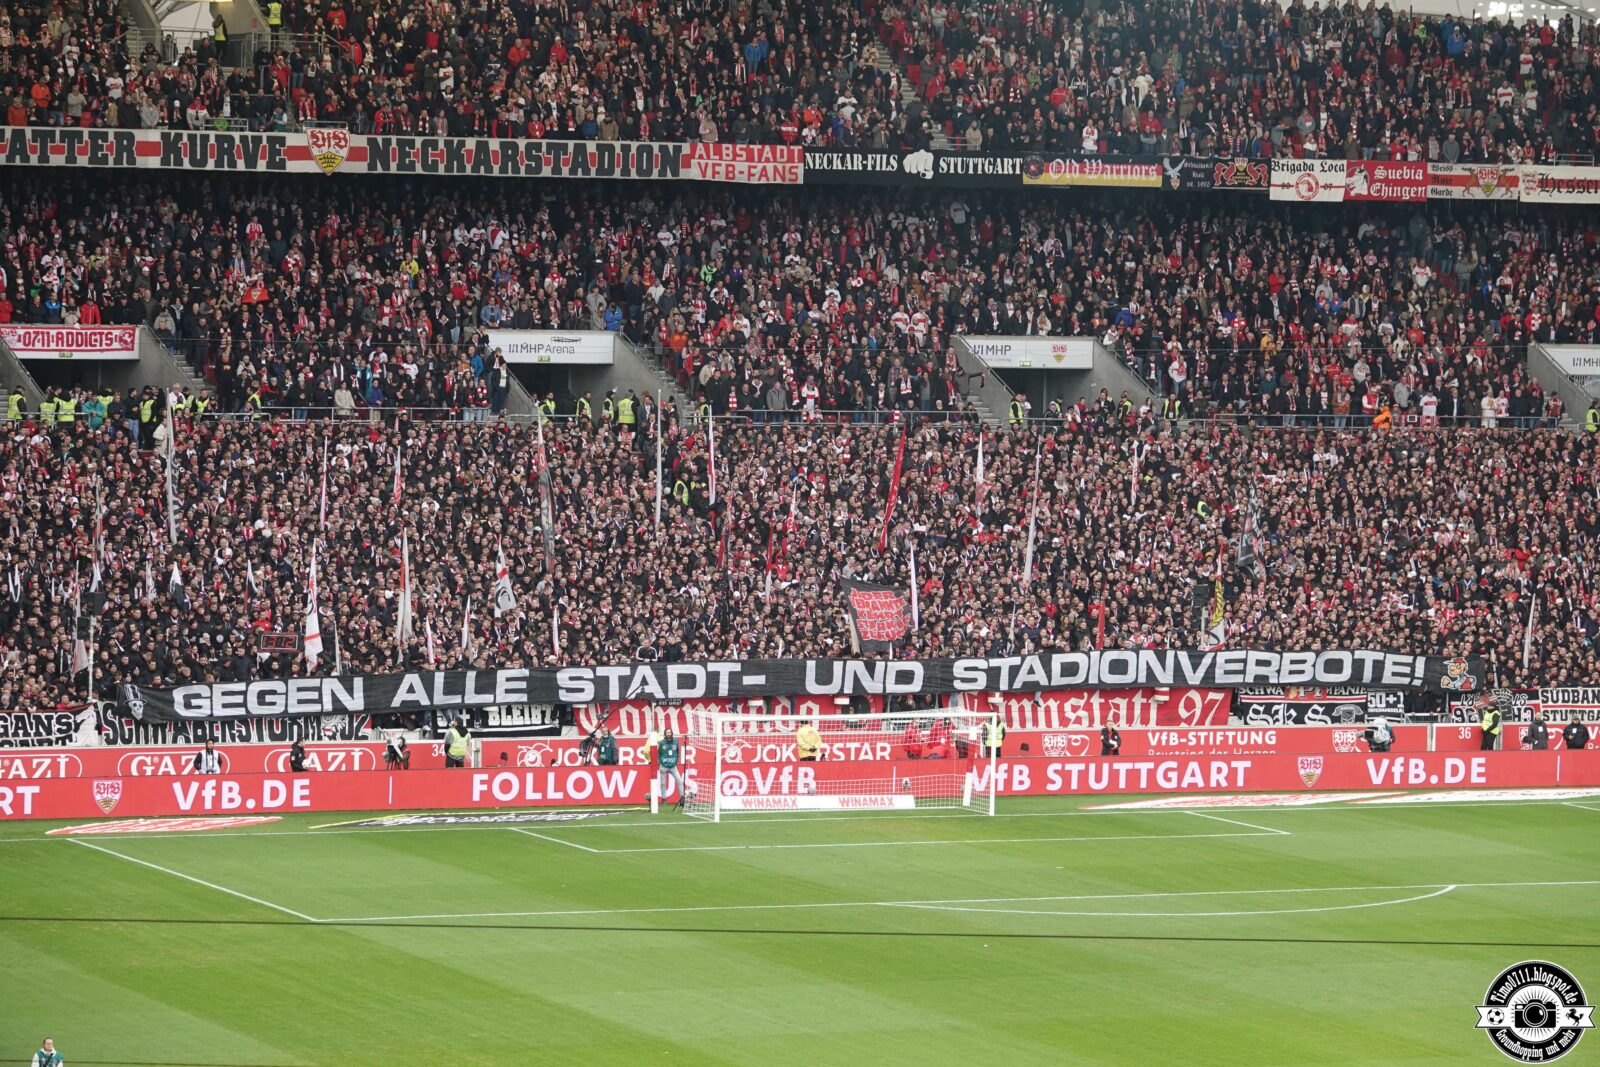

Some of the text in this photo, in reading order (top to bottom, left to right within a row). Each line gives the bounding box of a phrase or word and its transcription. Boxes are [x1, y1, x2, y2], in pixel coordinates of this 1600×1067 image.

[161, 131, 288, 171] KURVE
[367, 136, 683, 179] NECKARSTADION
[694, 143, 801, 164] ALBSTADT
[698, 164, 799, 183] VFB-FANS
[804, 152, 899, 172] NECKAR-FILS
[939, 156, 1023, 175] STUTTGART
[1048, 158, 1080, 179] Old
[1083, 158, 1158, 180] Warriors
[1271, 160, 1345, 174] Brigada Loca
[55, 331, 114, 348] ADDICTS
[985, 344, 1012, 356] MHP
[1583, 357, 1600, 367] MH
[172, 649, 1426, 717] GEGEN ALLE STADT- UND STADIONVERBOTE!
[1177, 689, 1226, 728] 97
[1367, 692, 1405, 709] 50+1
[1147, 730, 1277, 746] VfB-STIFTUNG
[1458, 726, 1471, 740] 36
[431, 744, 446, 757] 34
[750, 742, 891, 763] JOKRSTAR
[130, 755, 196, 777] GAZ
[1046, 760, 1252, 791] STUTTGART
[1366, 756, 1487, 786] VfB.DE
[472, 770, 638, 802] FOLLOW
[720, 765, 817, 797] @VfB
[172, 778, 311, 811] VfB.DE
